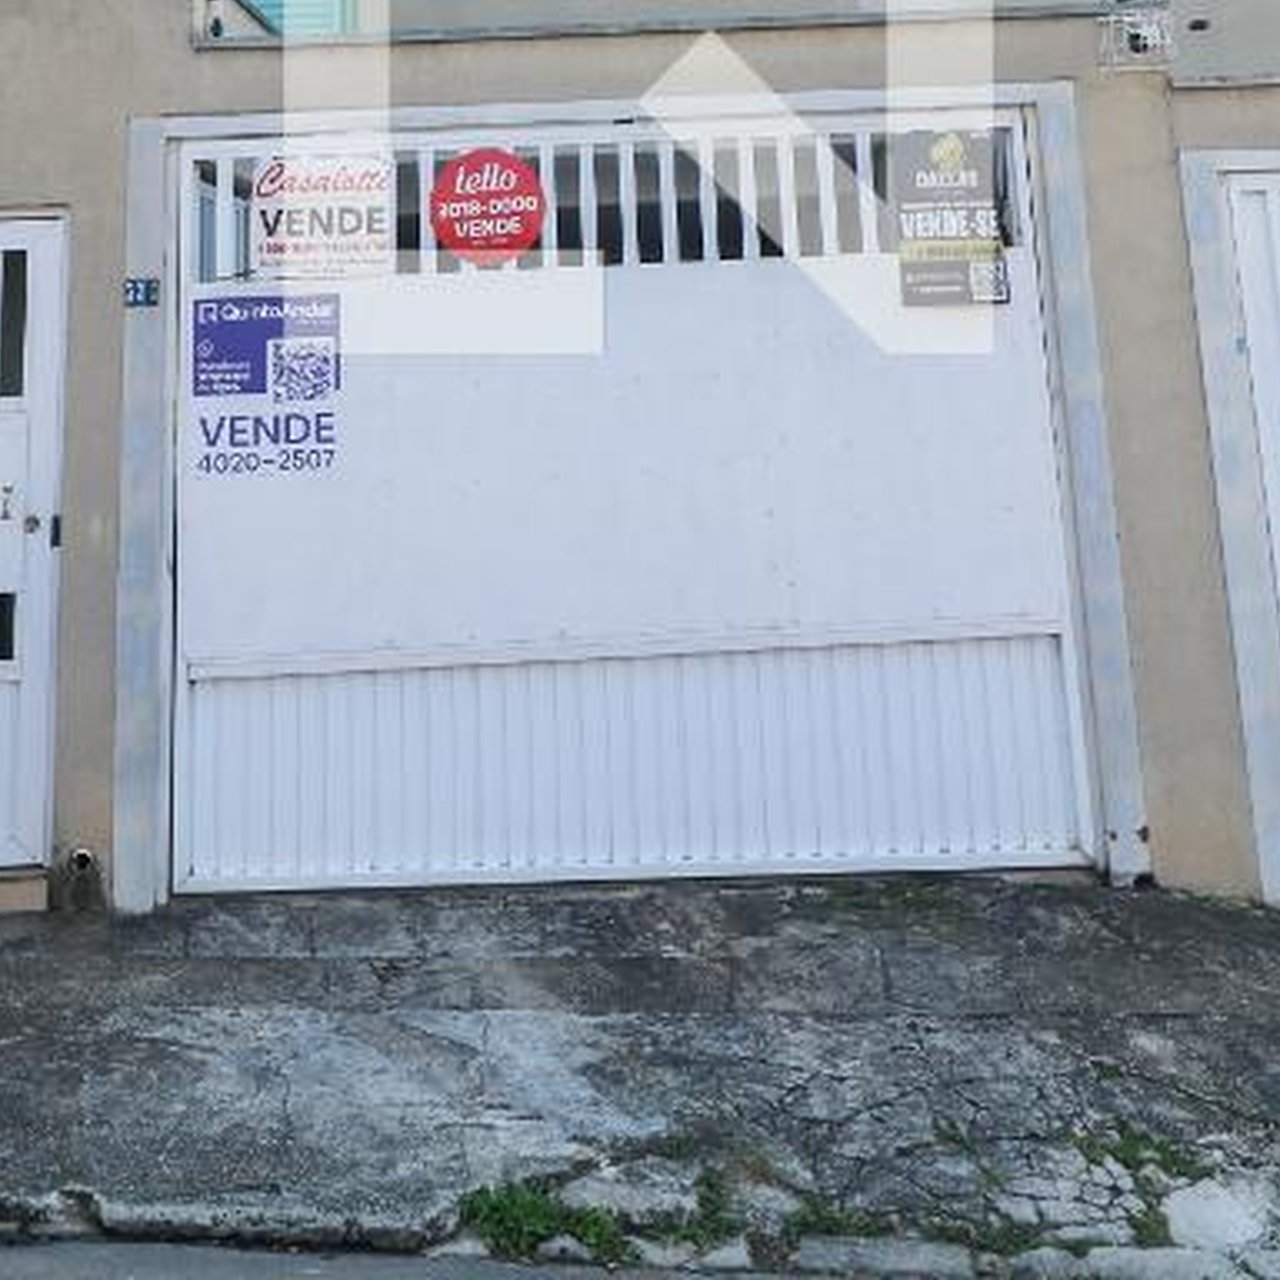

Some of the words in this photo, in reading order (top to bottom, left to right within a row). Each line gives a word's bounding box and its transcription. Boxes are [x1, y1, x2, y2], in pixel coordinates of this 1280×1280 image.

[260, 207, 385, 237] VENDE
[454, 216, 523, 238] VENDE
[899, 208, 1000, 238] VENDE-SE
[200, 412, 335, 447] VENDE
[198, 449, 336, 474] 4020-2507
